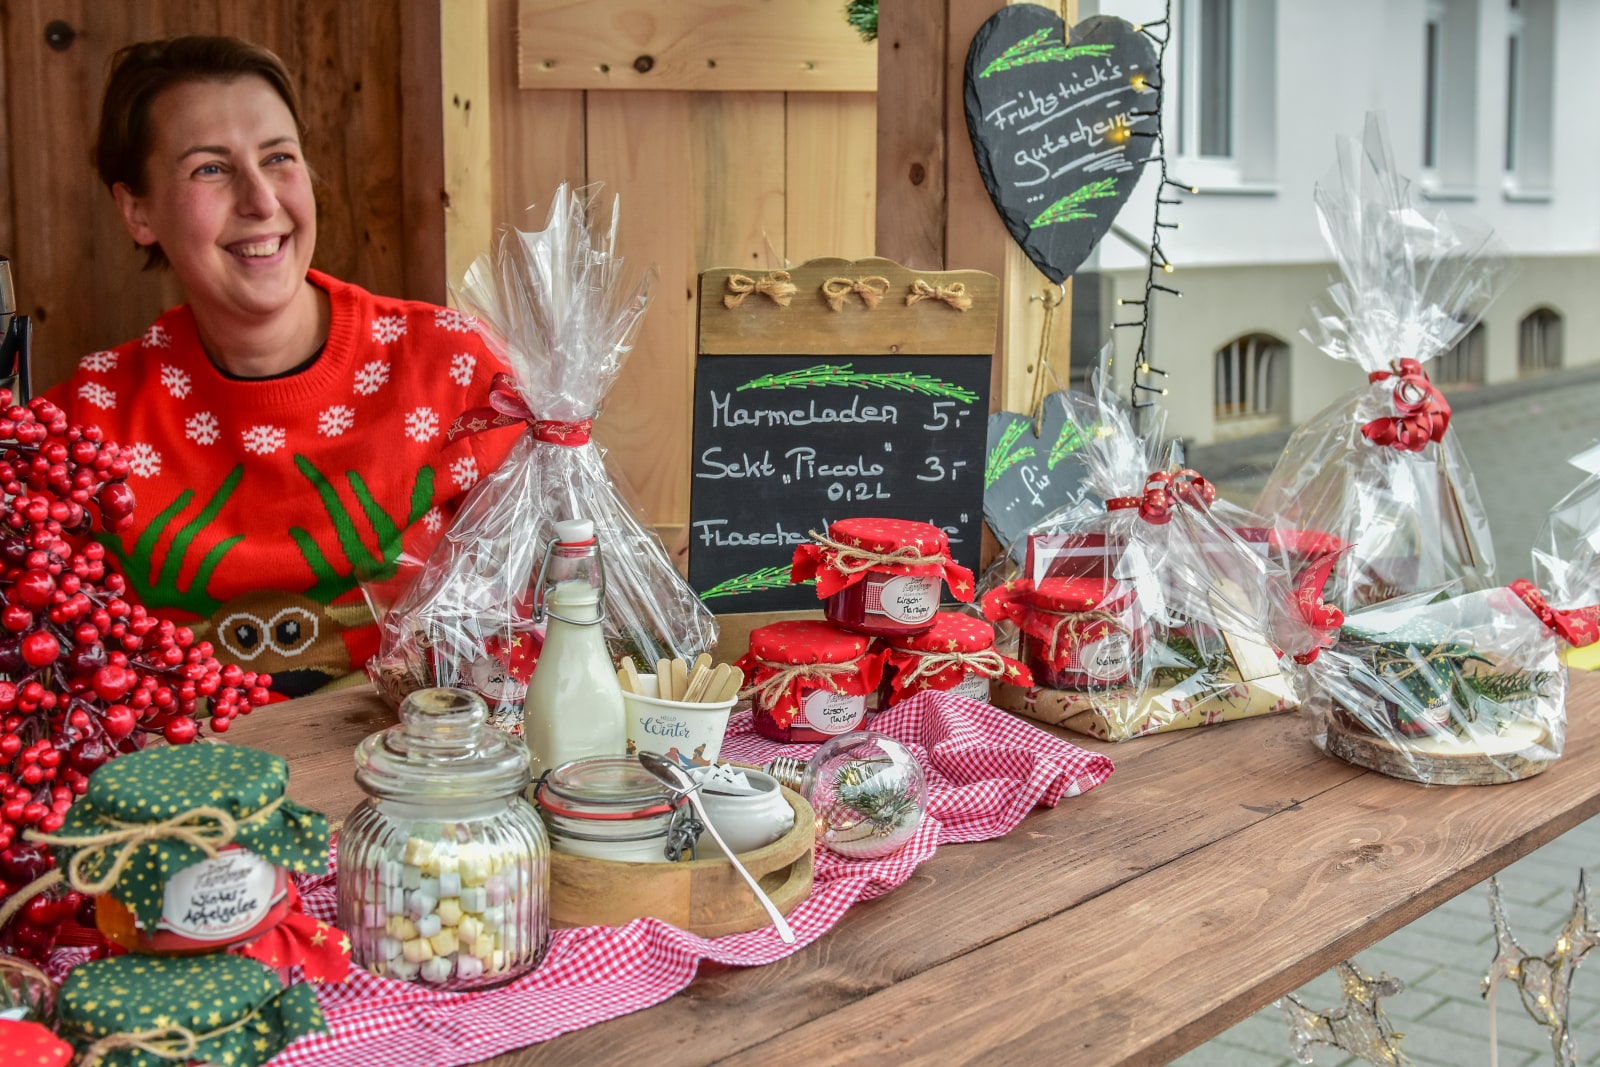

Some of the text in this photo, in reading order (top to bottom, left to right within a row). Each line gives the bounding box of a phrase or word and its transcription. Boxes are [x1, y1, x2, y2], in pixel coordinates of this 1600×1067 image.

[710, 390, 898, 427] Marmeladen
[696, 447, 775, 479] Sekt
[693, 519, 811, 546] Flasche
[640, 717, 690, 738] Winter
